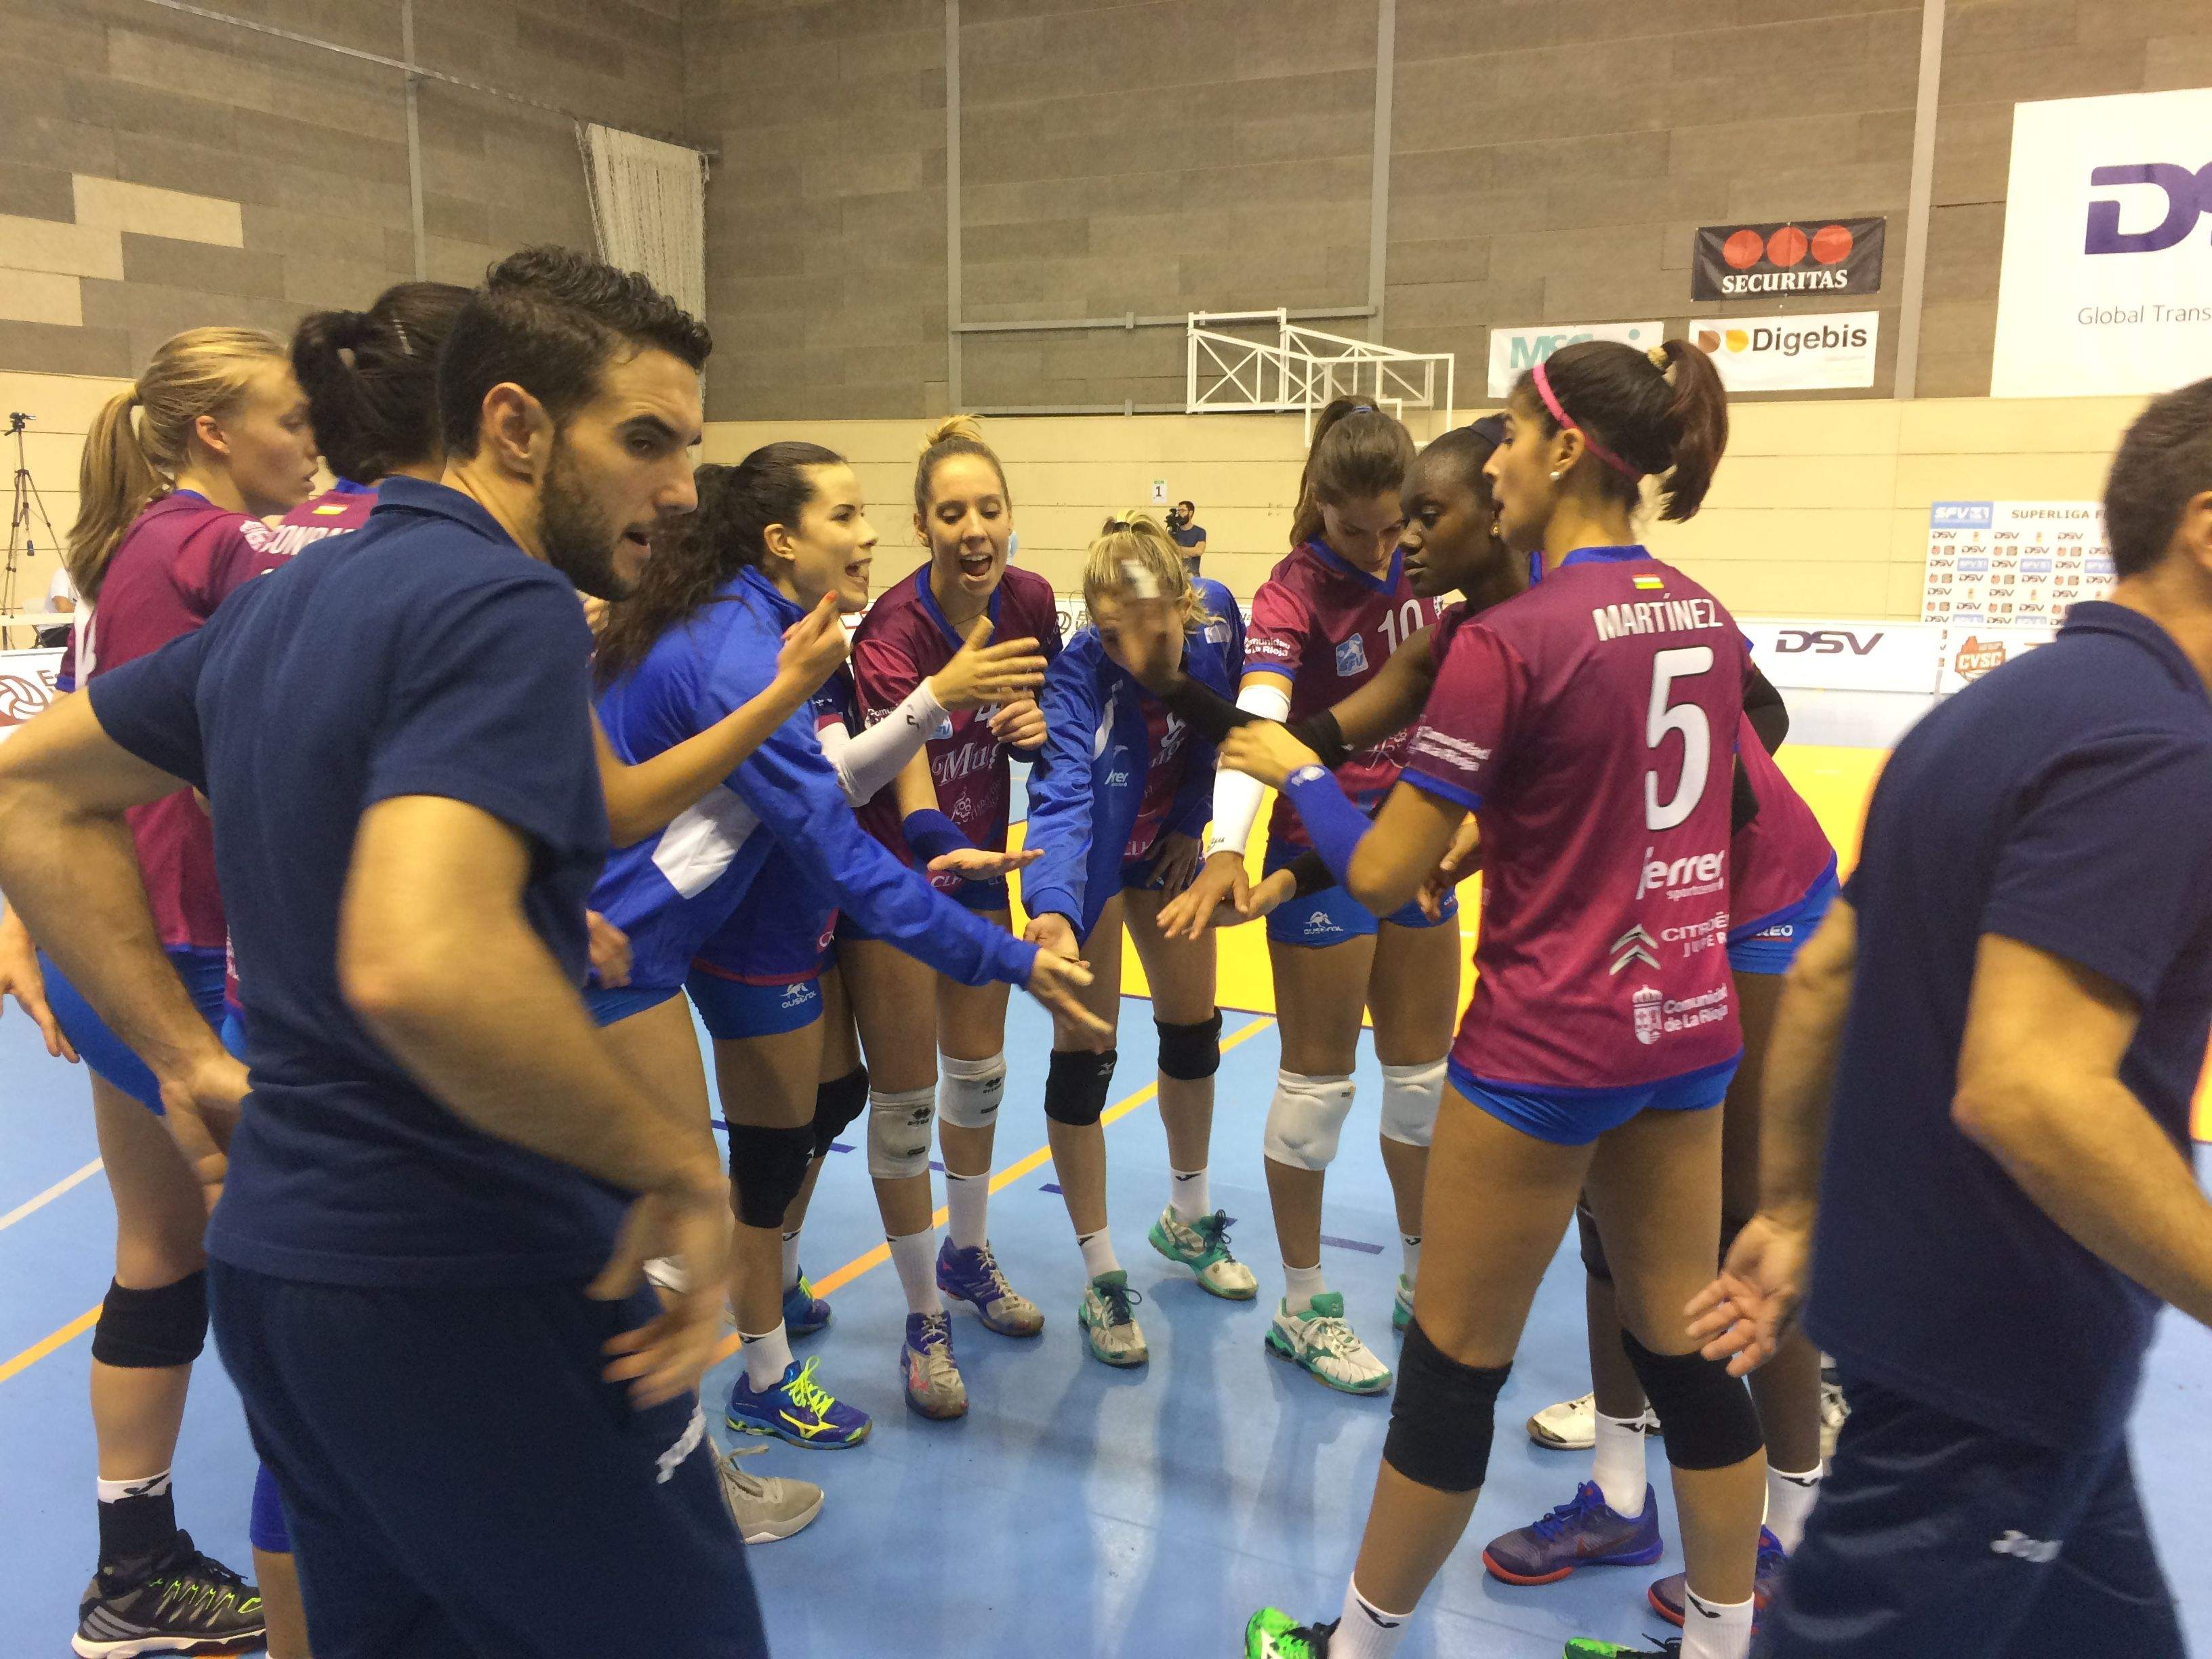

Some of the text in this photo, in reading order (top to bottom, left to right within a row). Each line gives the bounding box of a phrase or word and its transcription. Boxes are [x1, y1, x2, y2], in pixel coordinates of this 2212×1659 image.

[1722, 269, 1848, 293] SECURITAS
[2078, 306, 2144, 325] Global
[1753, 324, 1868, 356] Digebis
[2011, 510, 2089, 519] SUPERLIGA
[1932, 531, 1957, 539] DSV
[1994, 531, 2020, 540] DSV
[2057, 532, 2084, 540] DSV
[1961, 546, 1986, 554] DSV
[2024, 546, 2050, 554] DSV
[1929, 559, 1954, 567] DSV
[1992, 560, 2017, 568] DSV
[2055, 560, 2081, 569] DSV
[1959, 573, 1984, 581] DSV
[2022, 575, 2047, 583] DSV
[2086, 575, 2113, 583] DSV
[1927, 587, 1952, 596] DSV
[1989, 588, 2014, 597] DSV
[2052, 590, 2078, 598] DSV
[1957, 602, 1982, 610] DSV
[2019, 602, 2045, 611] DSV
[1593, 592, 1723, 641] MARTÍNEZ
[1378, 599, 1424, 659] 10
[1775, 630, 1884, 655] DSV
[1645, 646, 1714, 832] 5
